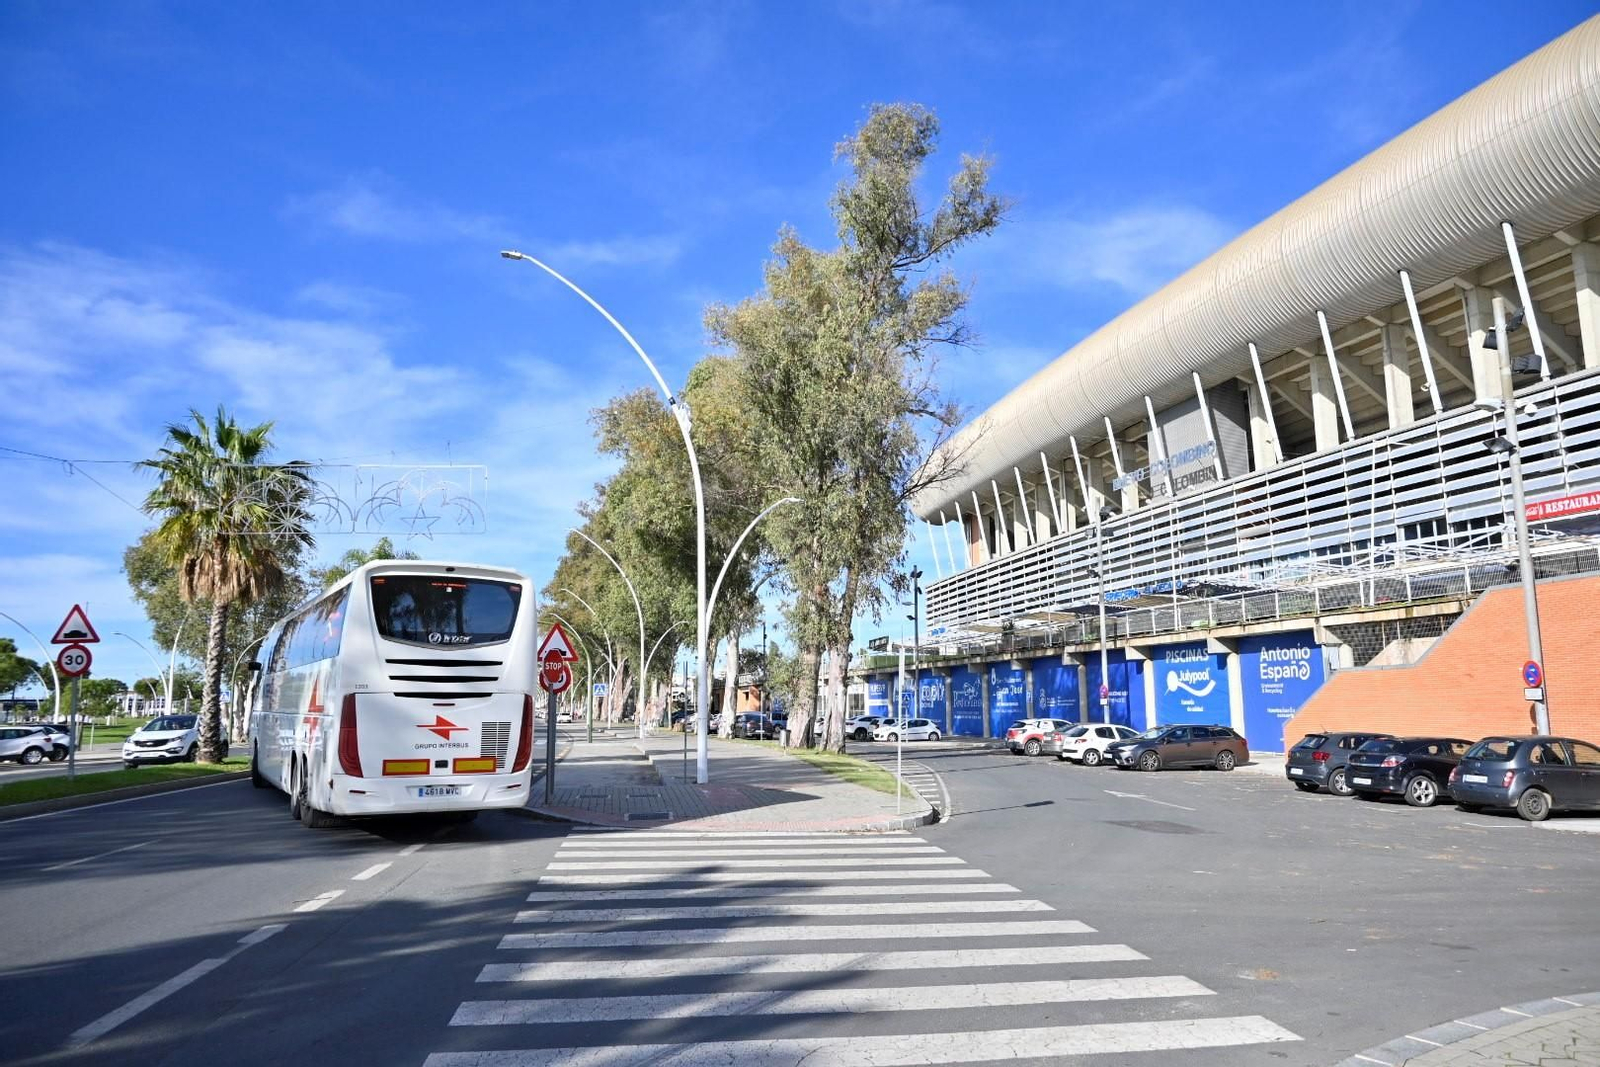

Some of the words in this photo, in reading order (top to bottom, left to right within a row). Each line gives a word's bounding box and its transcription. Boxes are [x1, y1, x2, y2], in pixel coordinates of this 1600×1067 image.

[1165, 648, 1209, 664] PISCINAS
[1260, 643, 1310, 662] Antonio
[65, 655, 84, 665] 30
[545, 662, 562, 670] STOP
[1178, 667, 1209, 684] Julypool
[445, 787, 460, 796] MVC
